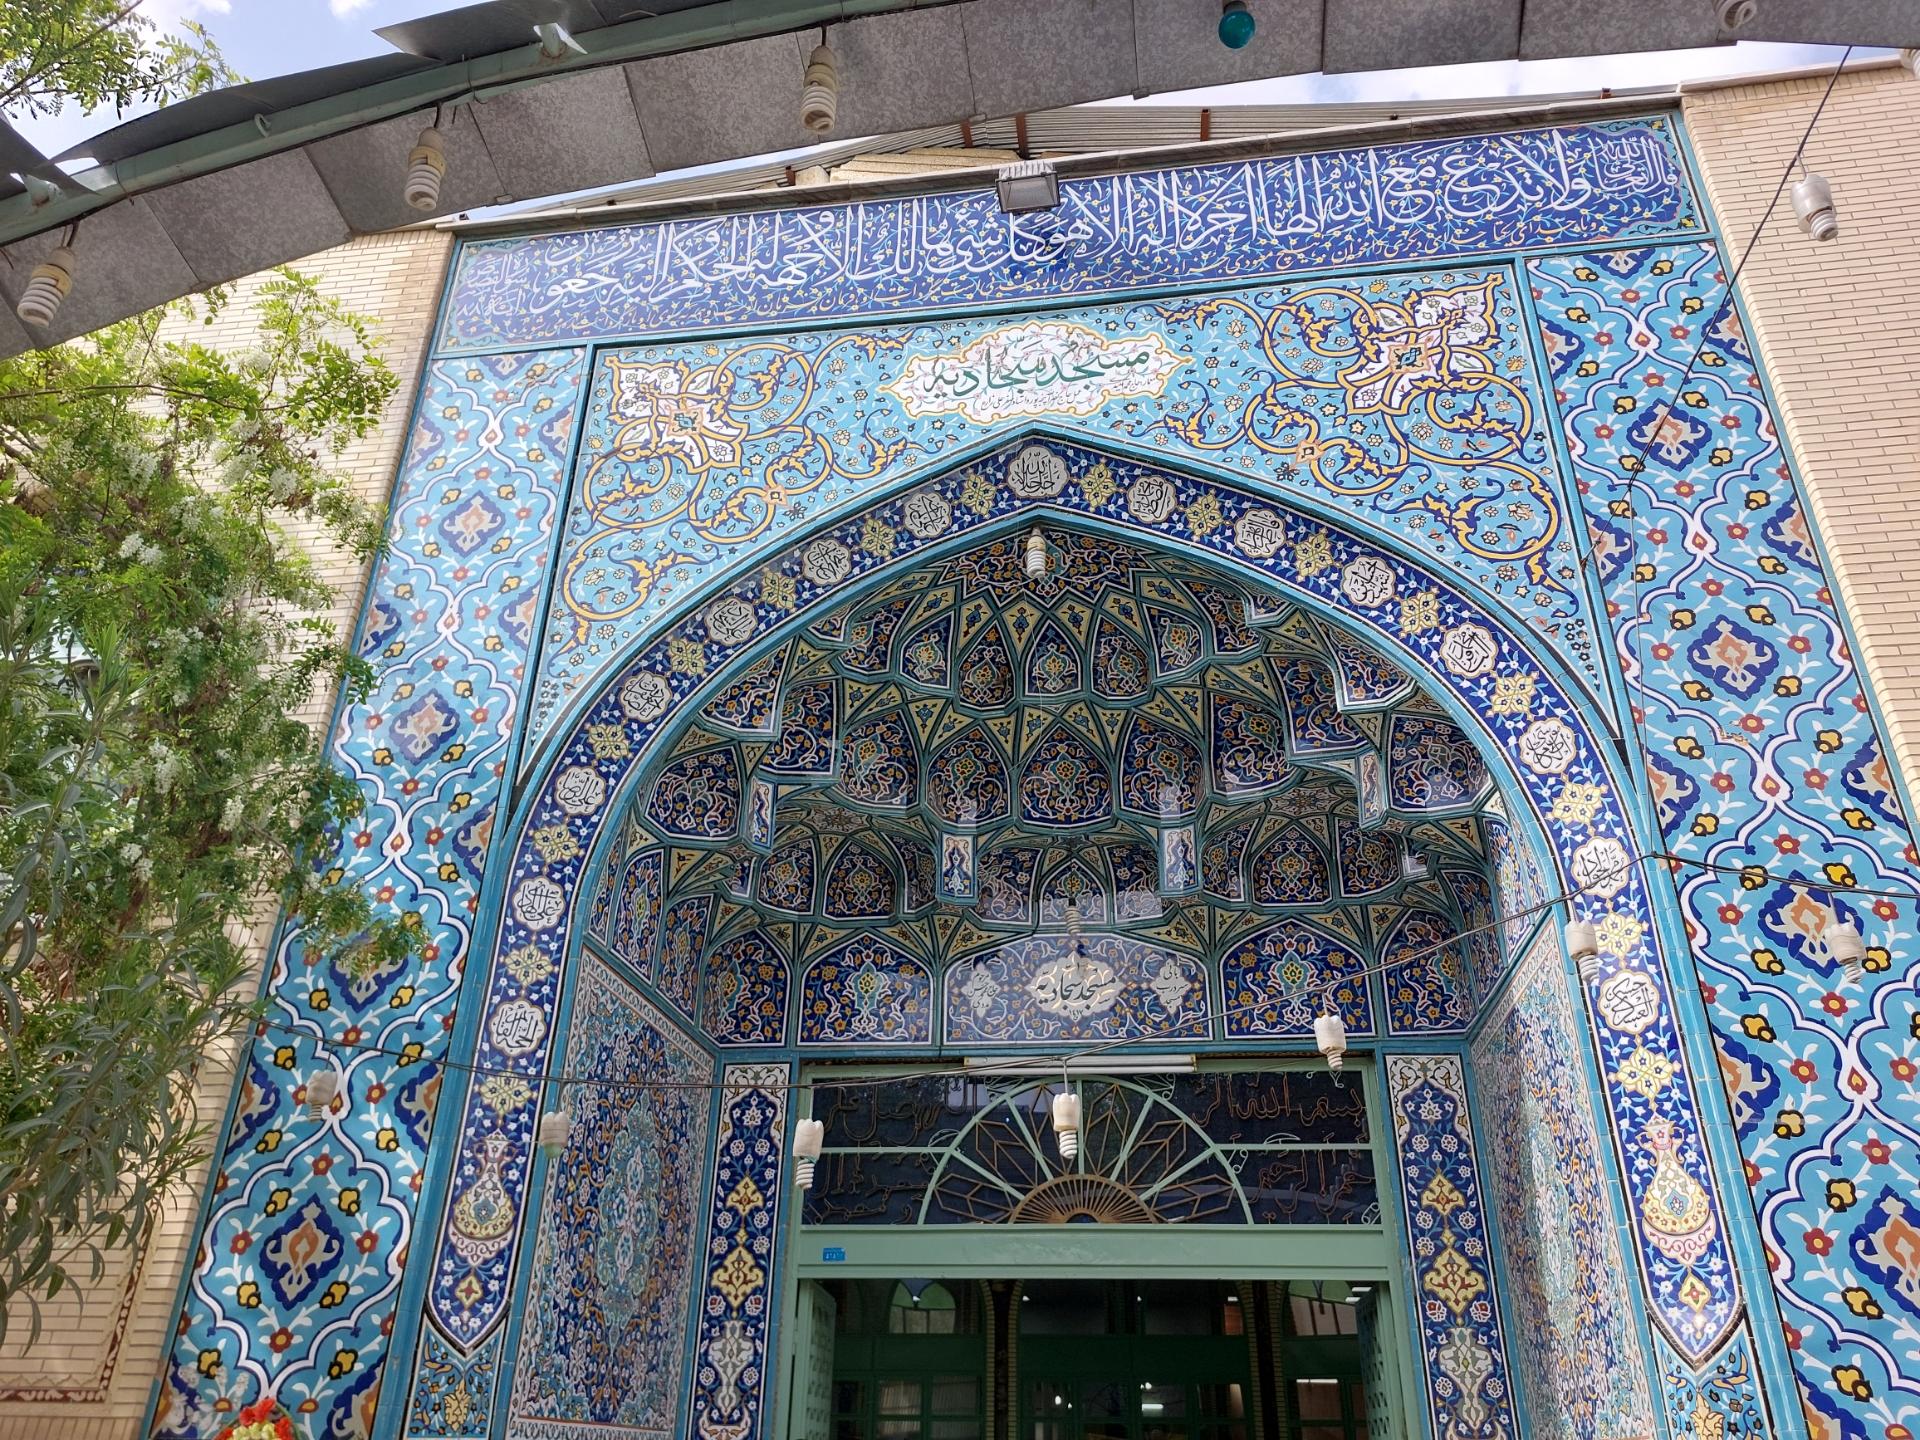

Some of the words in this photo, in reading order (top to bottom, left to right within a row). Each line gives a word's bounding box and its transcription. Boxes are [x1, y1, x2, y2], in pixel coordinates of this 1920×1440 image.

[1322, 149, 1383, 228] الله
[922, 345, 1047, 400] سجادیه
[1035, 349, 1151, 391] مسجد
[1073, 975, 1116, 1010] مسجد
